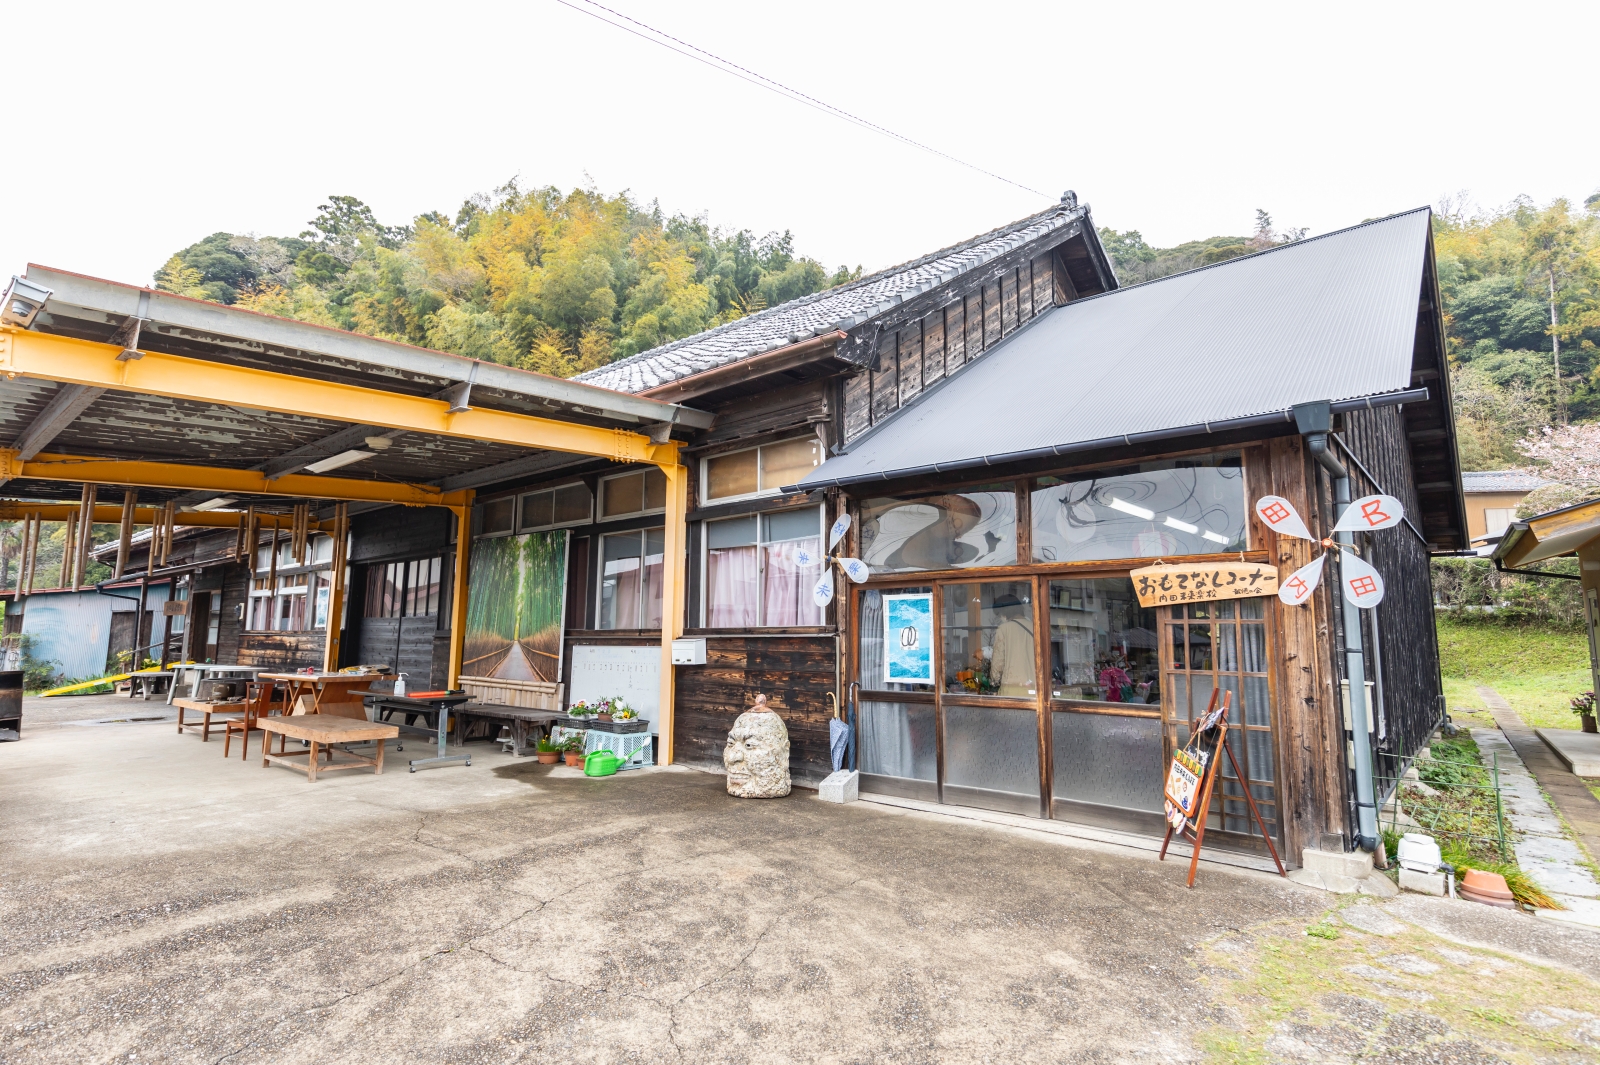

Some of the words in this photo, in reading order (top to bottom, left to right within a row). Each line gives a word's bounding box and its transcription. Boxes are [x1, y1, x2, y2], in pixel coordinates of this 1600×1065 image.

[1260, 500, 1290, 525] 田
[1361, 499, 1391, 526] 内
[1139, 567, 1277, 597] おもてなしコーナー
[1286, 576, 1309, 599] 内
[1349, 575, 1377, 597] 田
